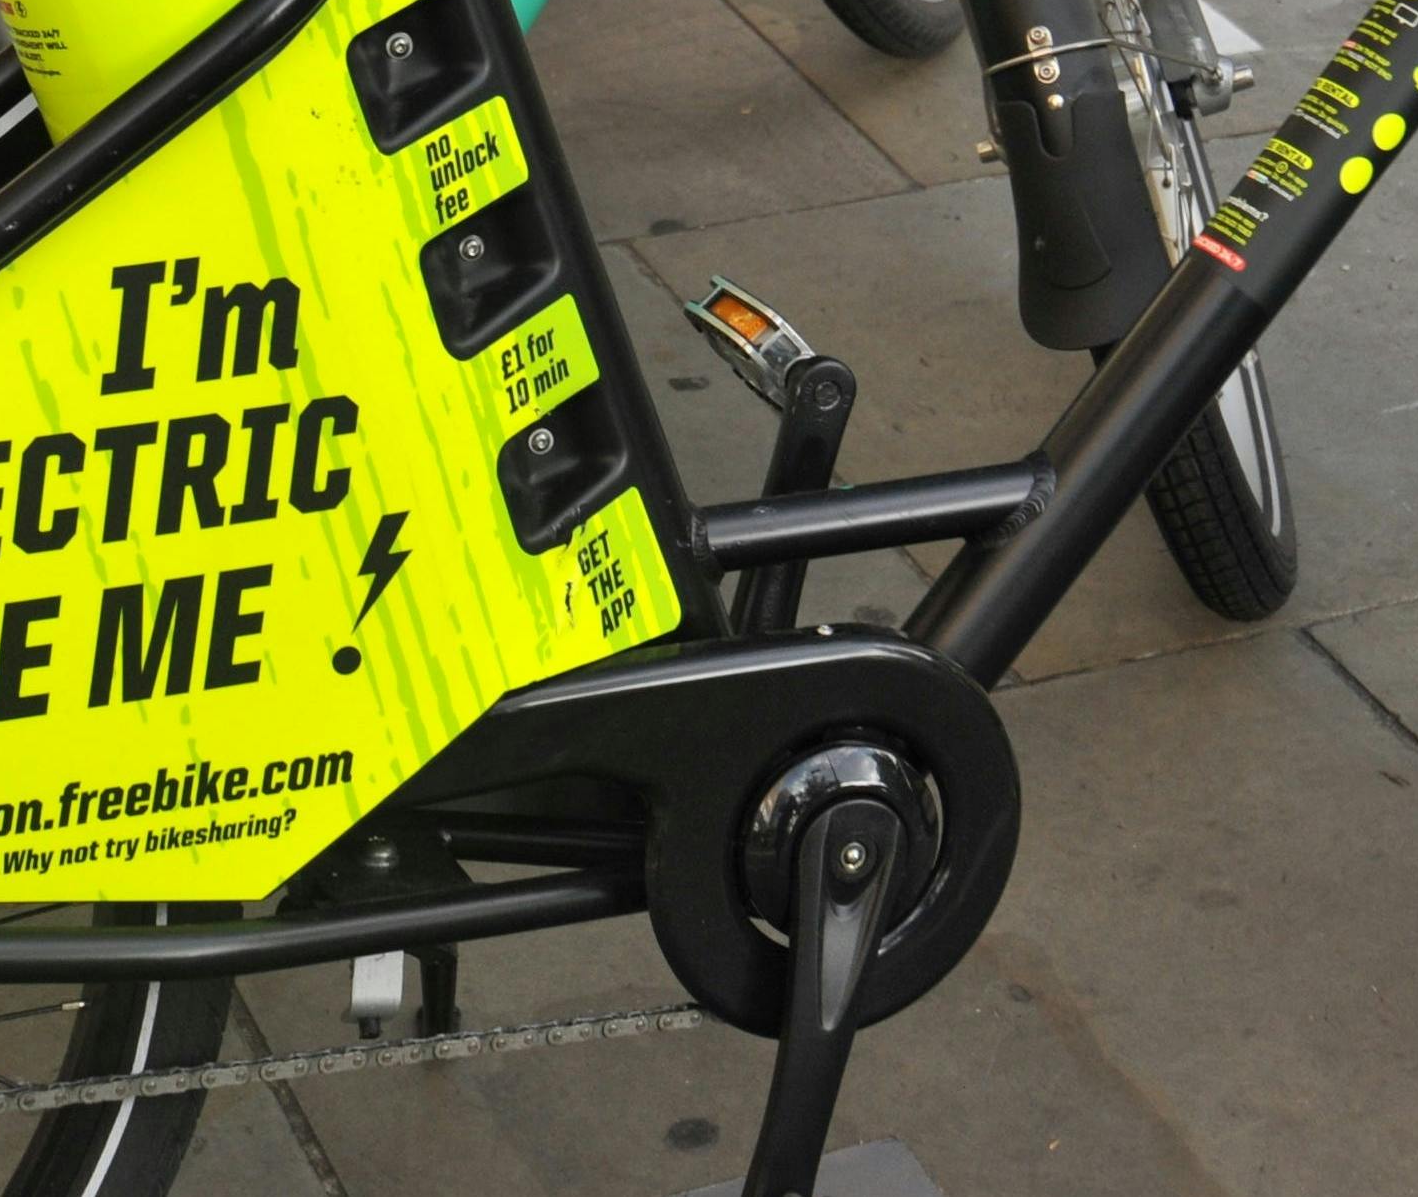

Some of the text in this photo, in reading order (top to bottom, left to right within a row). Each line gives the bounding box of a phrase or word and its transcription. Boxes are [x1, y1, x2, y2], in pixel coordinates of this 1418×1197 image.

[425, 134, 452, 166] no
[430, 131, 501, 191] unlock
[435, 187, 470, 226] fee
[100, 256, 301, 396] I'm
[500, 328, 556, 382] £1 for
[505, 355, 571, 415] 10 min
[577, 530, 609, 571] GET
[587, 564, 625, 606] THE
[87, 563, 274, 709] ME
[601, 591, 636, 639] APP
[2, 807, 297, 875] Why not try bikesharing?
